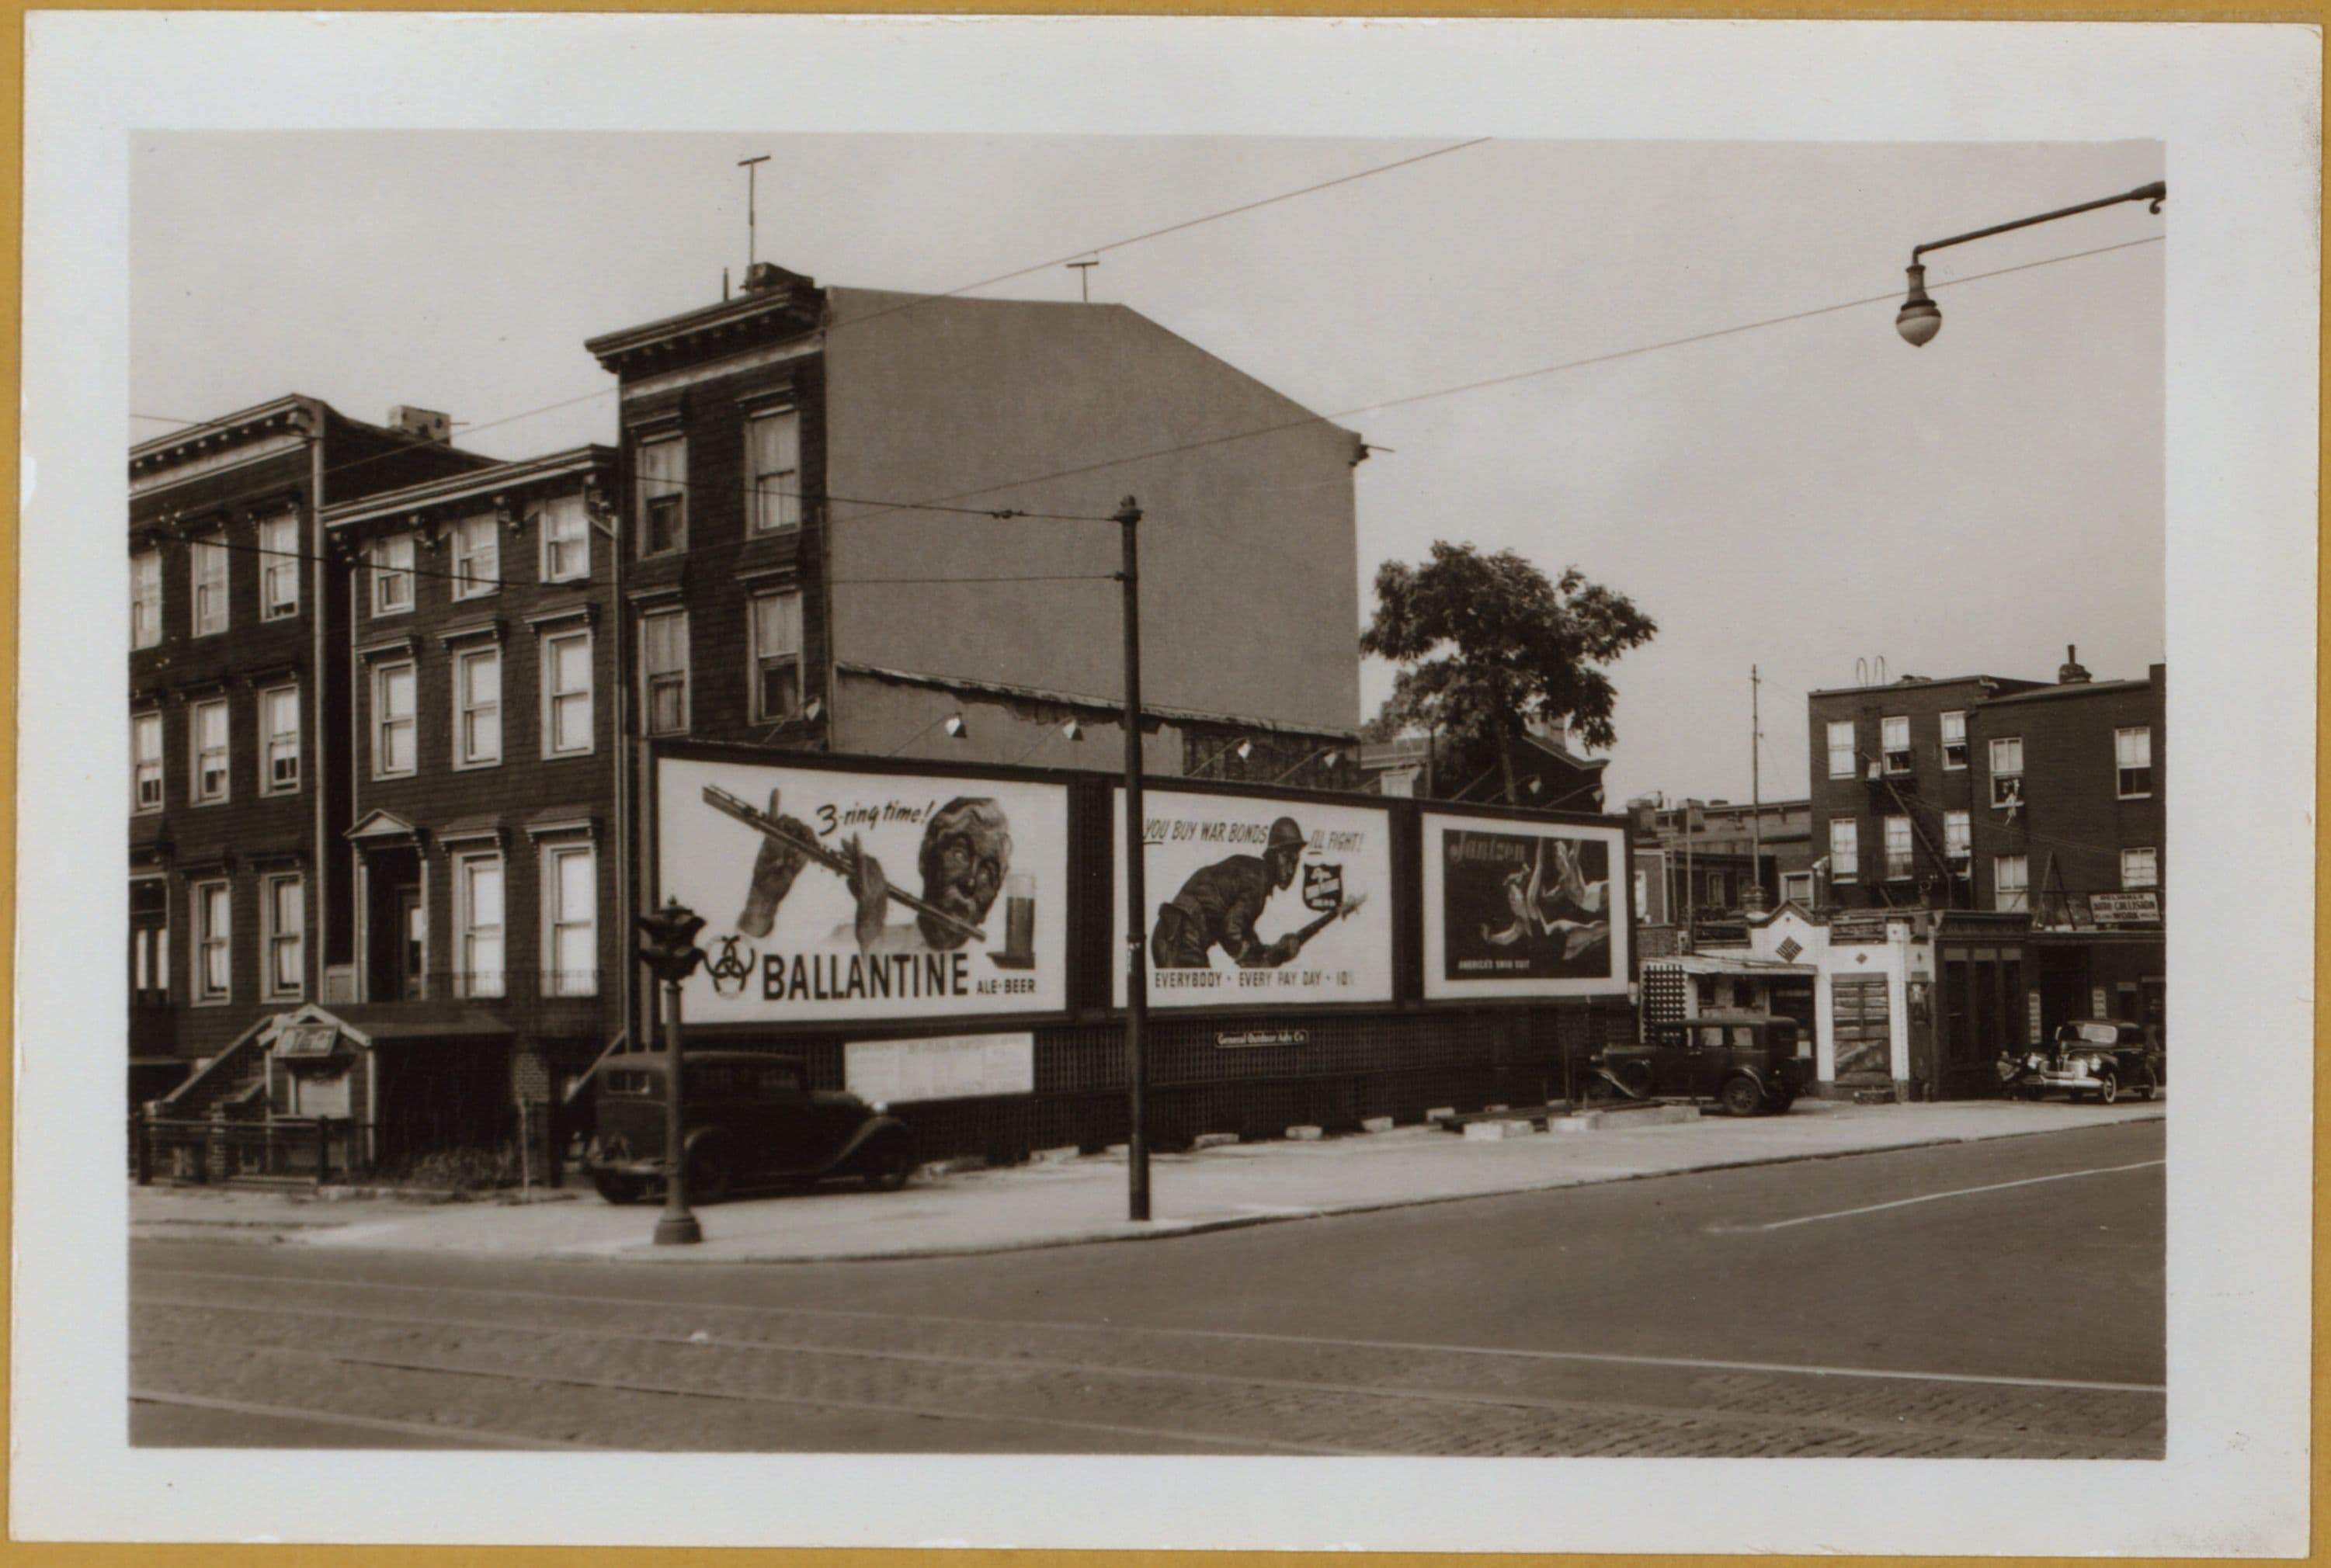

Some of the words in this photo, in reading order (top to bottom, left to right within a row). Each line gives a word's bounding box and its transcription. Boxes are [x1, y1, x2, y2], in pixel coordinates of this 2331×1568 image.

[884, 800, 935, 824] time!
[1143, 819, 1169, 839] YOU
[1172, 820, 1197, 840] BUY
[1200, 821, 1227, 841] WAR
[1228, 823, 1268, 843] BONDS
[1450, 831, 1525, 862] Jantzen
[763, 953, 968, 1001] BALLANTINE
[1155, 971, 1222, 987] EVERYBODY
[1239, 971, 1272, 987] EVERY
[1278, 971, 1298, 987] PAY
[1303, 971, 1321, 987] DAY
